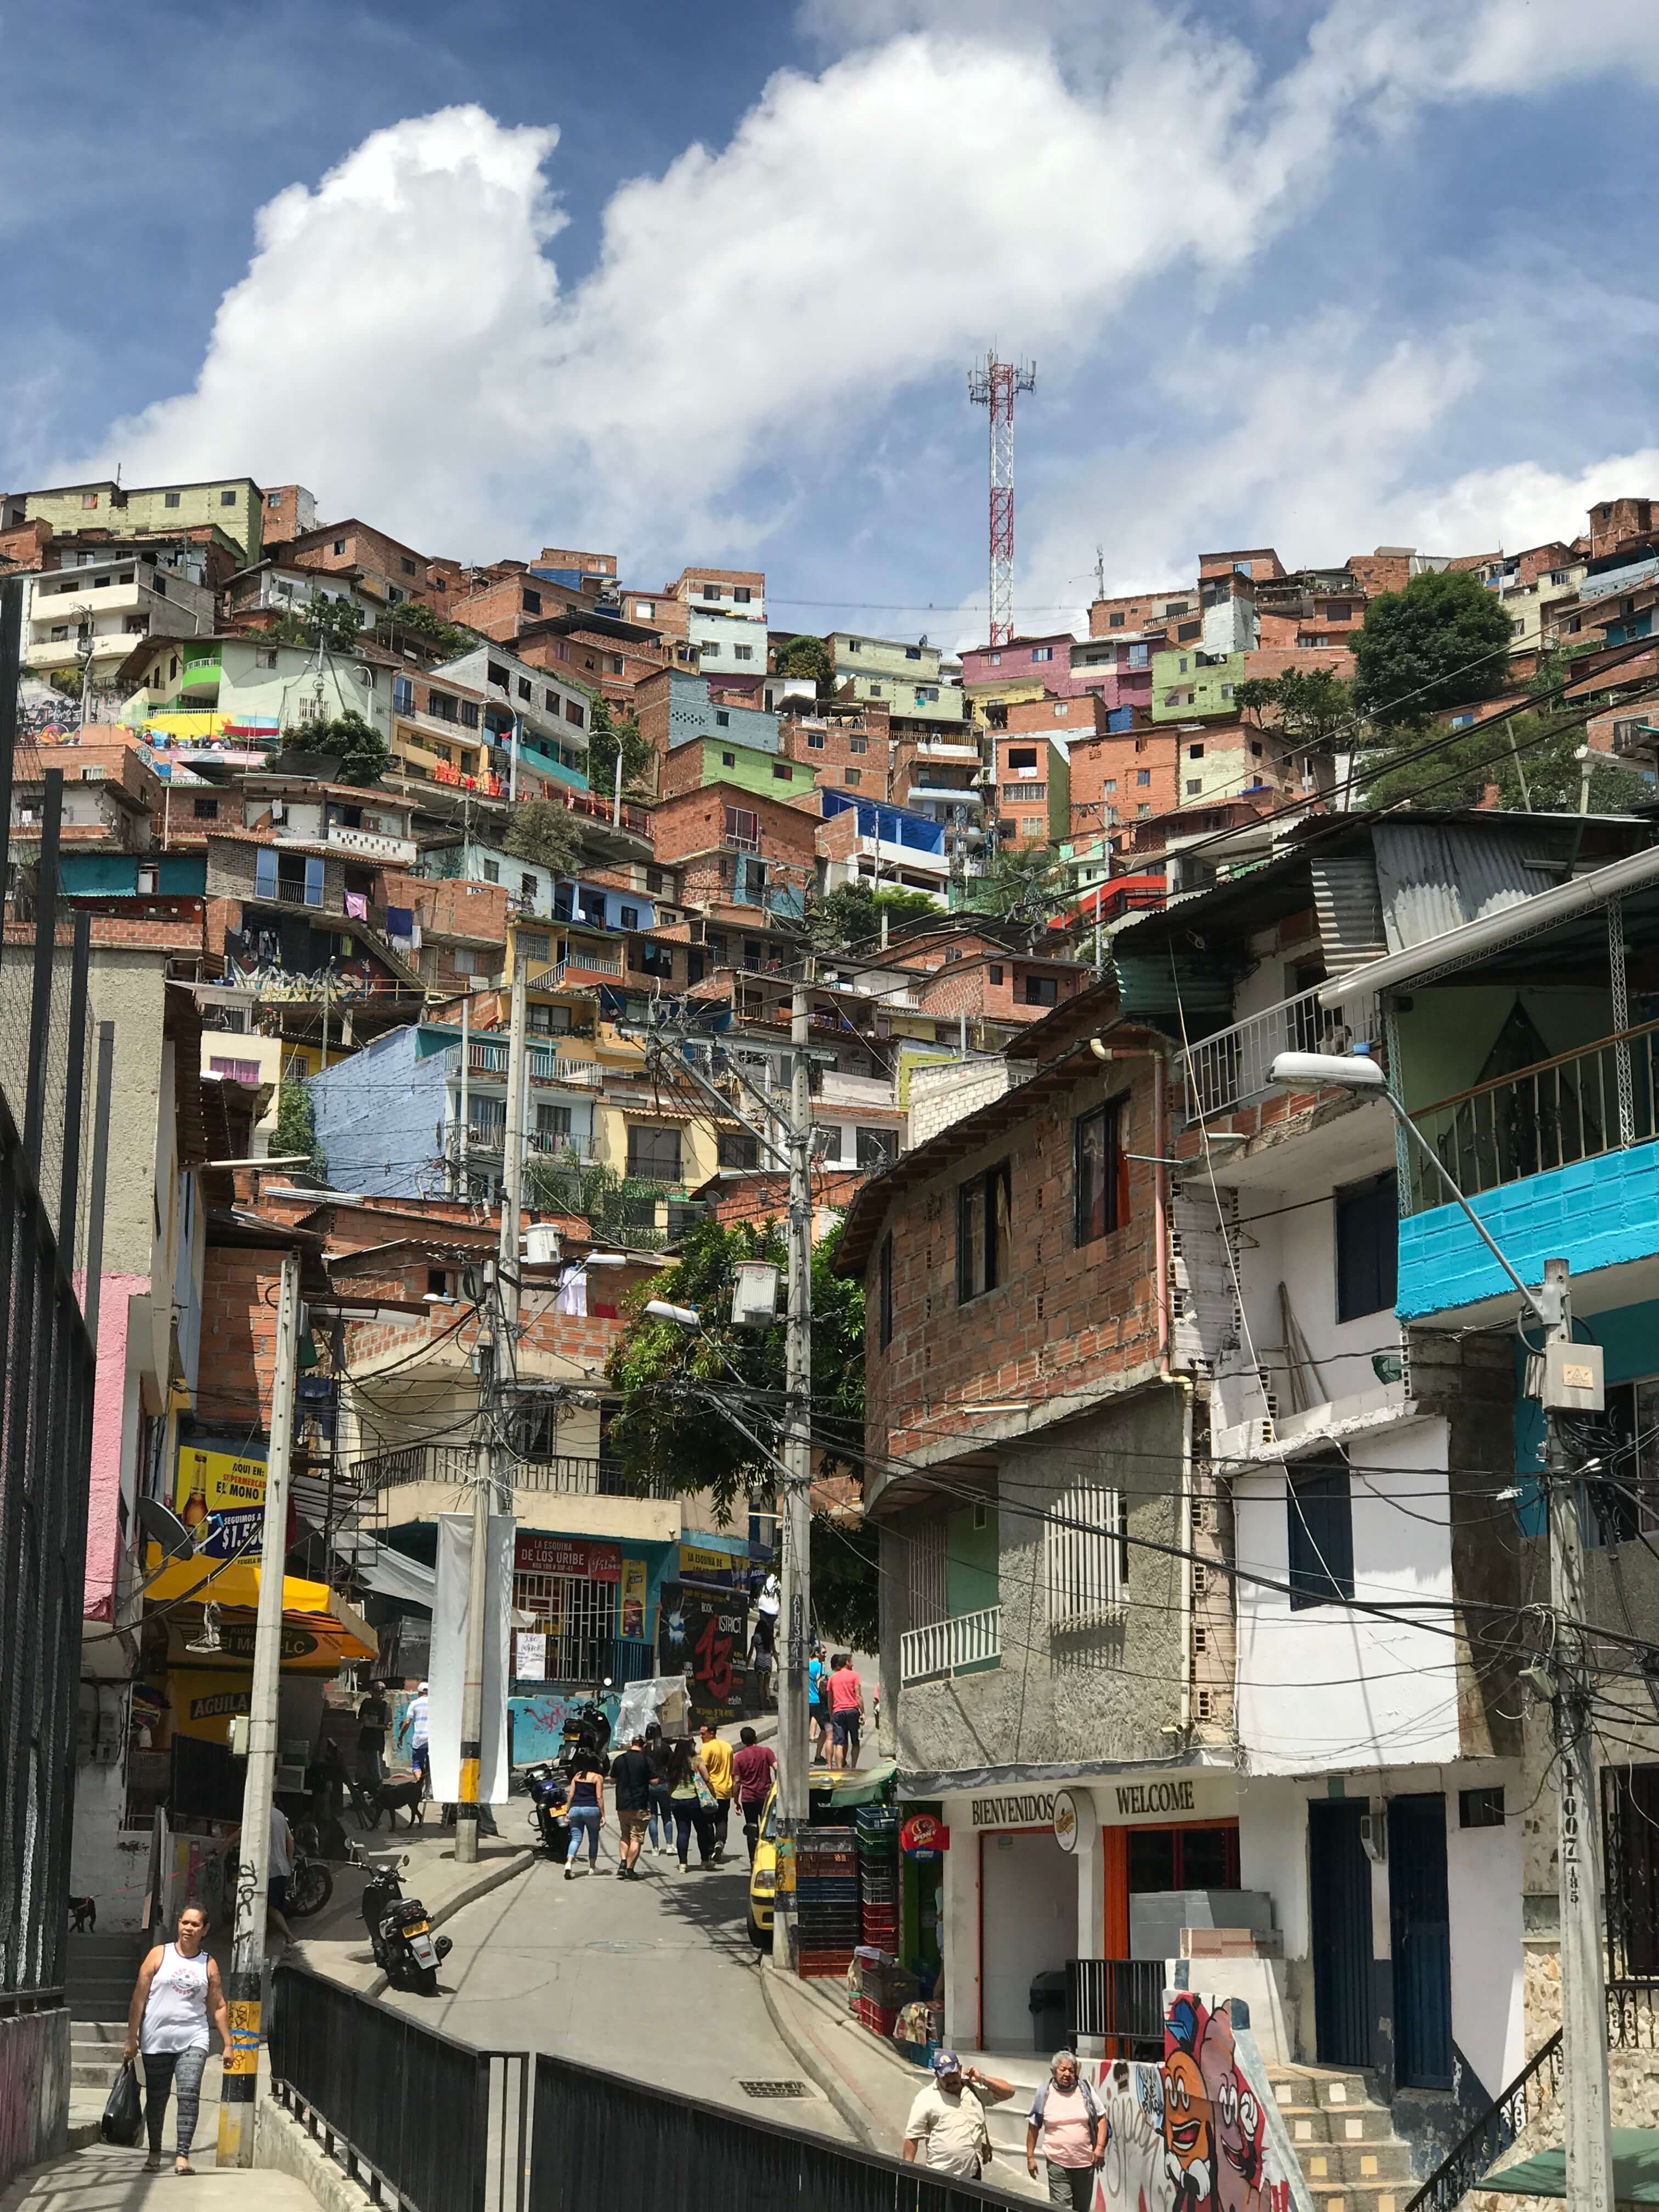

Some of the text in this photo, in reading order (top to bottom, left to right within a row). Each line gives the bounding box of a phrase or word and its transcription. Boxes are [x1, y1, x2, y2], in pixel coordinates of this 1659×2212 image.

[233, 1463, 264, 1477] AQUI EN:
[223, 1474, 267, 1488] SUPERMERCAD
[229, 1485, 259, 1500] MONO
[224, 1515, 255, 1525] SEGUIMOS
[534, 1541, 572, 1551] LA ESQUINA
[522, 1549, 584, 1565] DE LOS URIBE
[751, 1569, 766, 1577] AGUIL
[1116, 1781, 1194, 1814] WELCOME
[972, 1794, 1054, 1826] BIENVENIDOS
